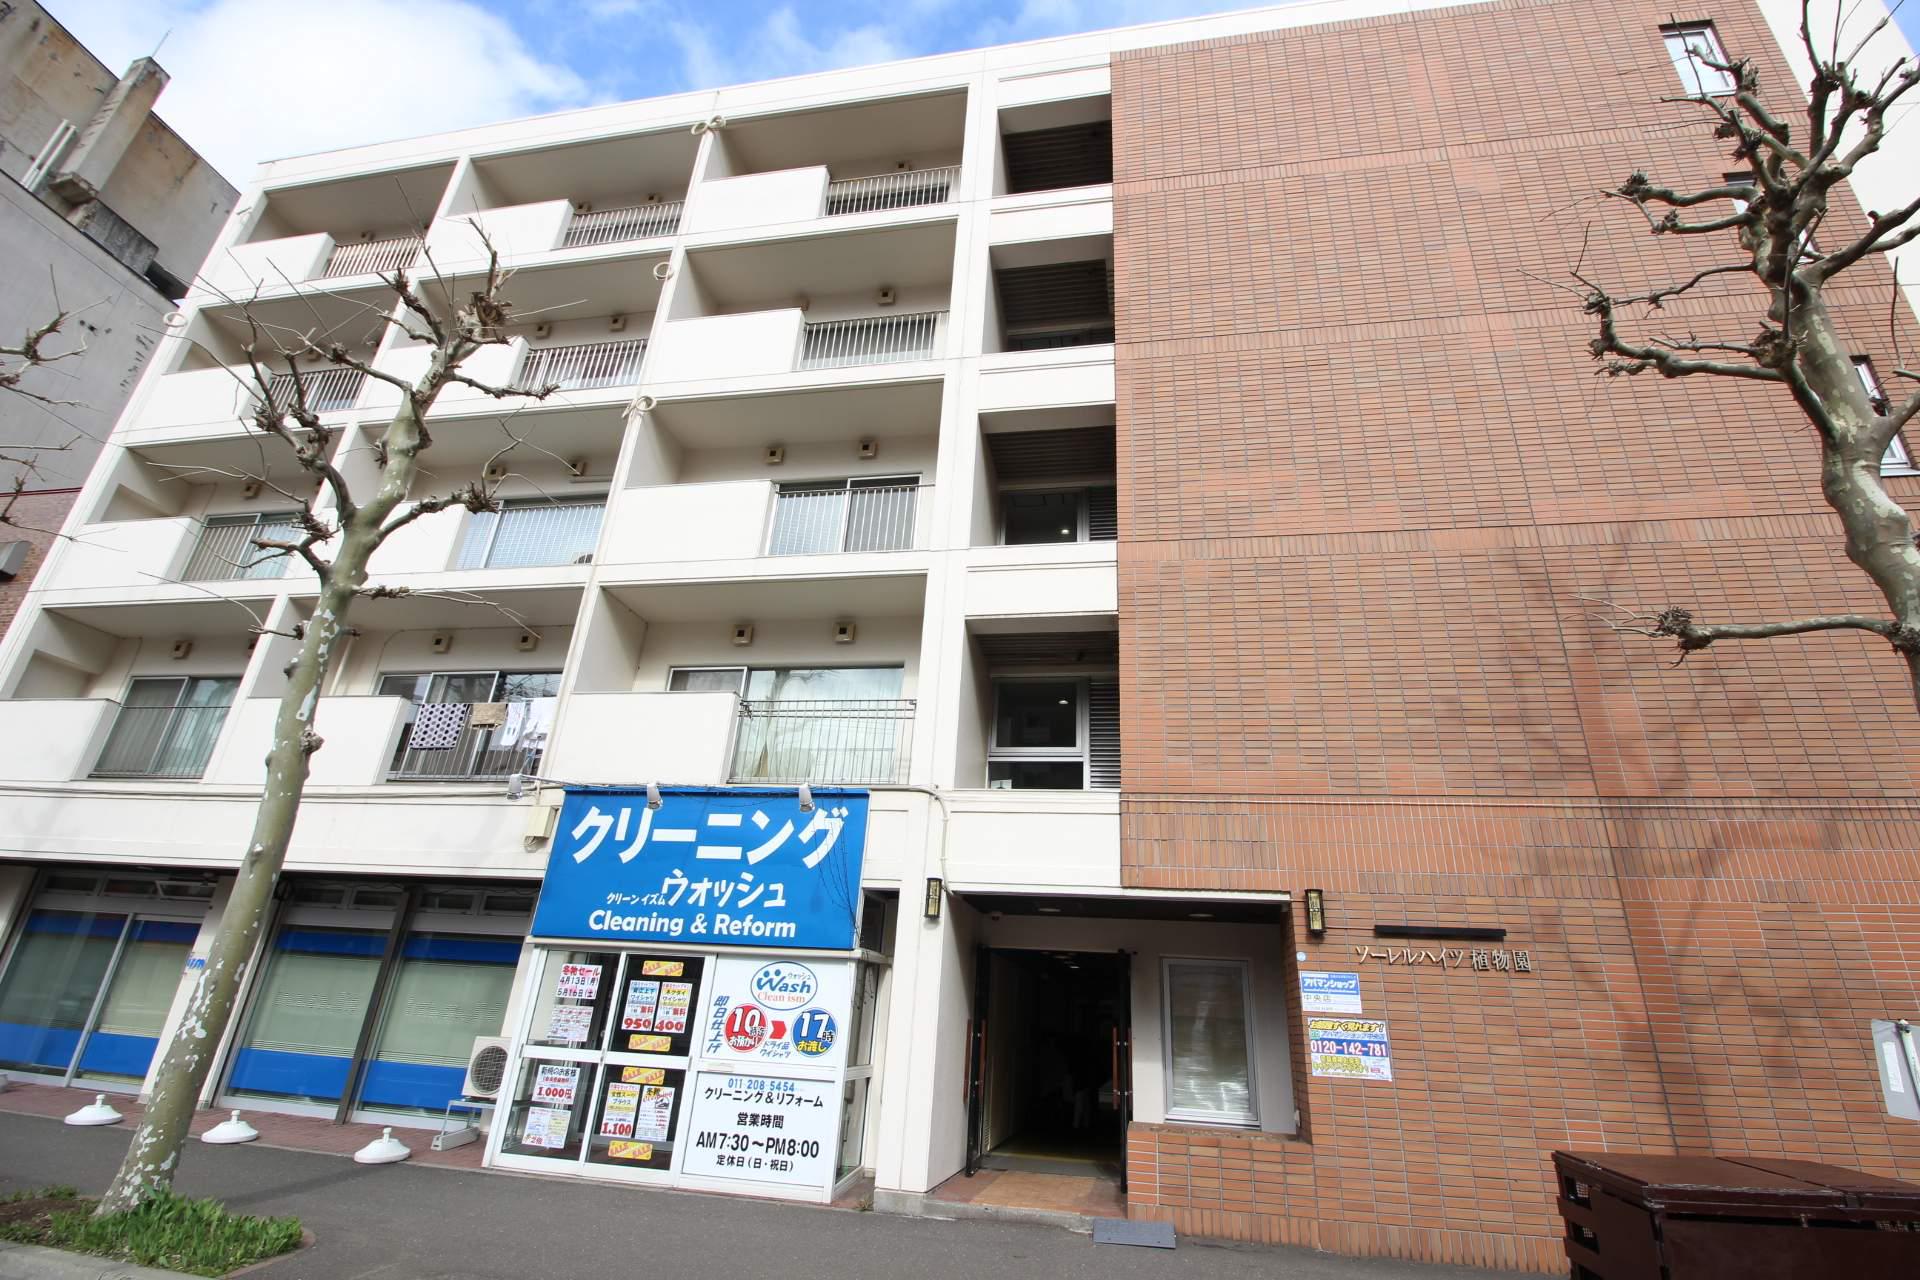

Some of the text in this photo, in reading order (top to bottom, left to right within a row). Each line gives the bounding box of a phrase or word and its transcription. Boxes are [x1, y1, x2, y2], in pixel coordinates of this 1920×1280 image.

[571, 806, 849, 869] クリーニング
[588, 909, 796, 938] Cleaning & Reform
[1355, 945, 1532, 972] ソーレルハイツ 植物園
[757, 991, 806, 1003] Clean ism
[706, 995, 730, 1054] 即日仕上げ
[1311, 1040, 1387, 1056] 0120-142-781
[728, 1078, 795, 1092] 011 208 5454
[737, 1112, 784, 1129] 営業時間
